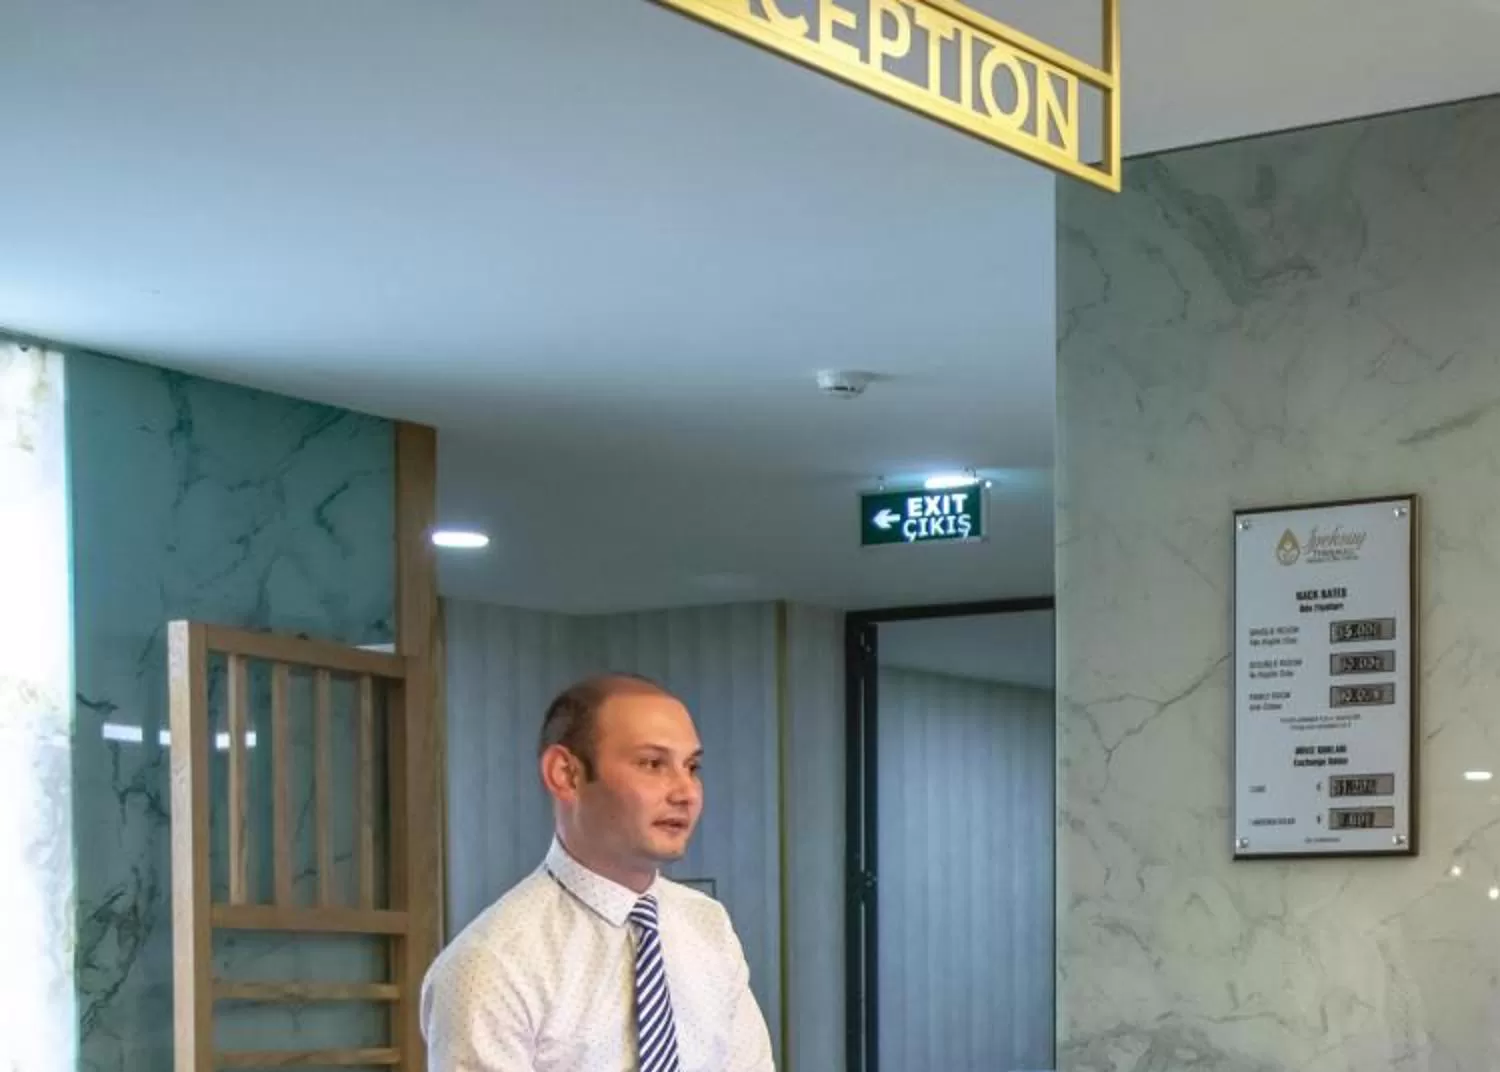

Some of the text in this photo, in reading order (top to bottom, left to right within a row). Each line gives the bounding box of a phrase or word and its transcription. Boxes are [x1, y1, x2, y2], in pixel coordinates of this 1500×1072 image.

[742, 0, 1080, 163] CEPTION
[907, 493, 968, 517] EXIT
[903, 514, 972, 542] ÇIKIŞ
